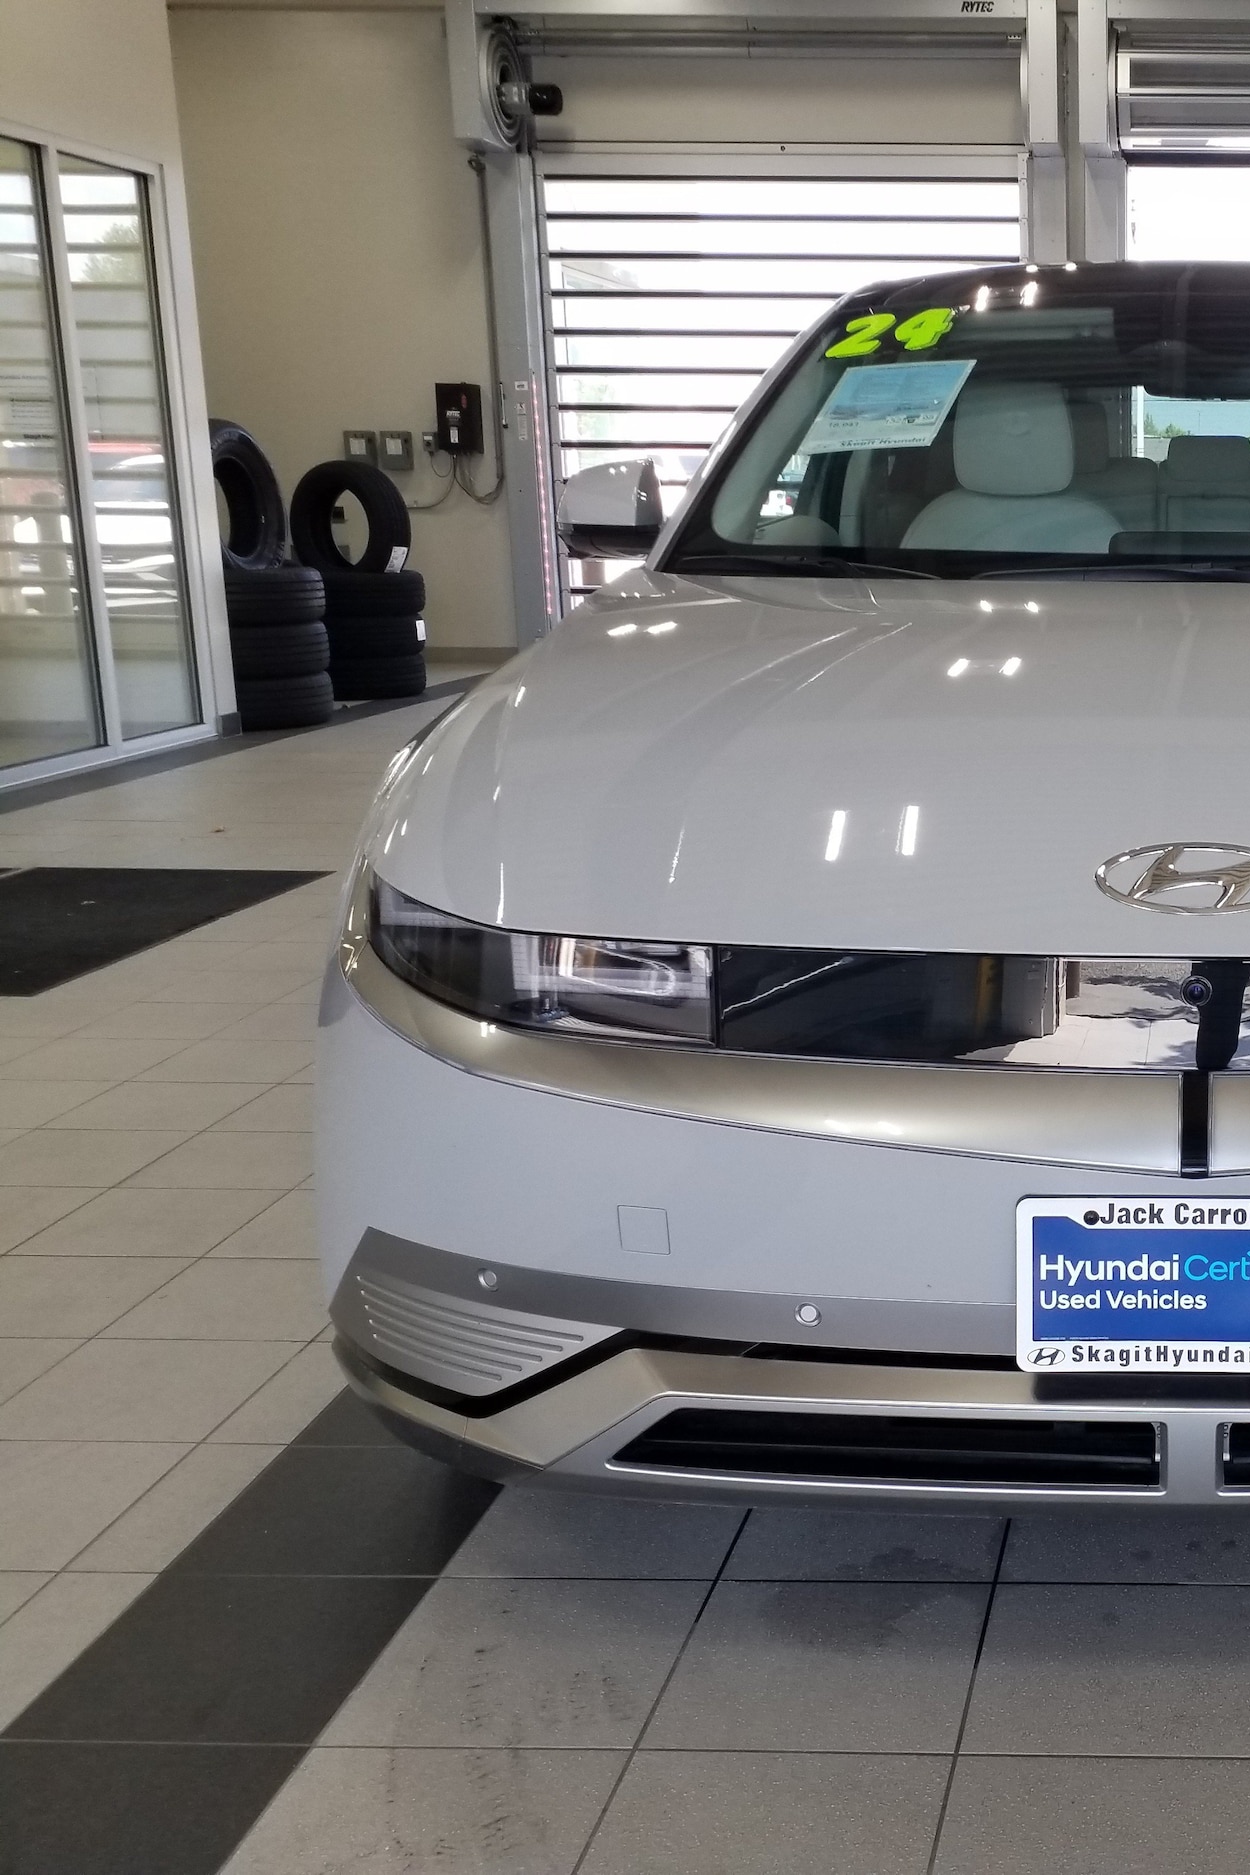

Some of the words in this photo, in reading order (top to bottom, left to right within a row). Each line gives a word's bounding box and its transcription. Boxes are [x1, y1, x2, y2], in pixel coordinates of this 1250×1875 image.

[961, 1, 995, 13] RYTEC
[825, 308, 954, 358] 24
[1100, 1203, 1165, 1225] Jack
[1040, 1254, 1180, 1287] Hyundai
[1040, 1290, 1101, 1310] Used
[1106, 1290, 1208, 1310] Vehicles
